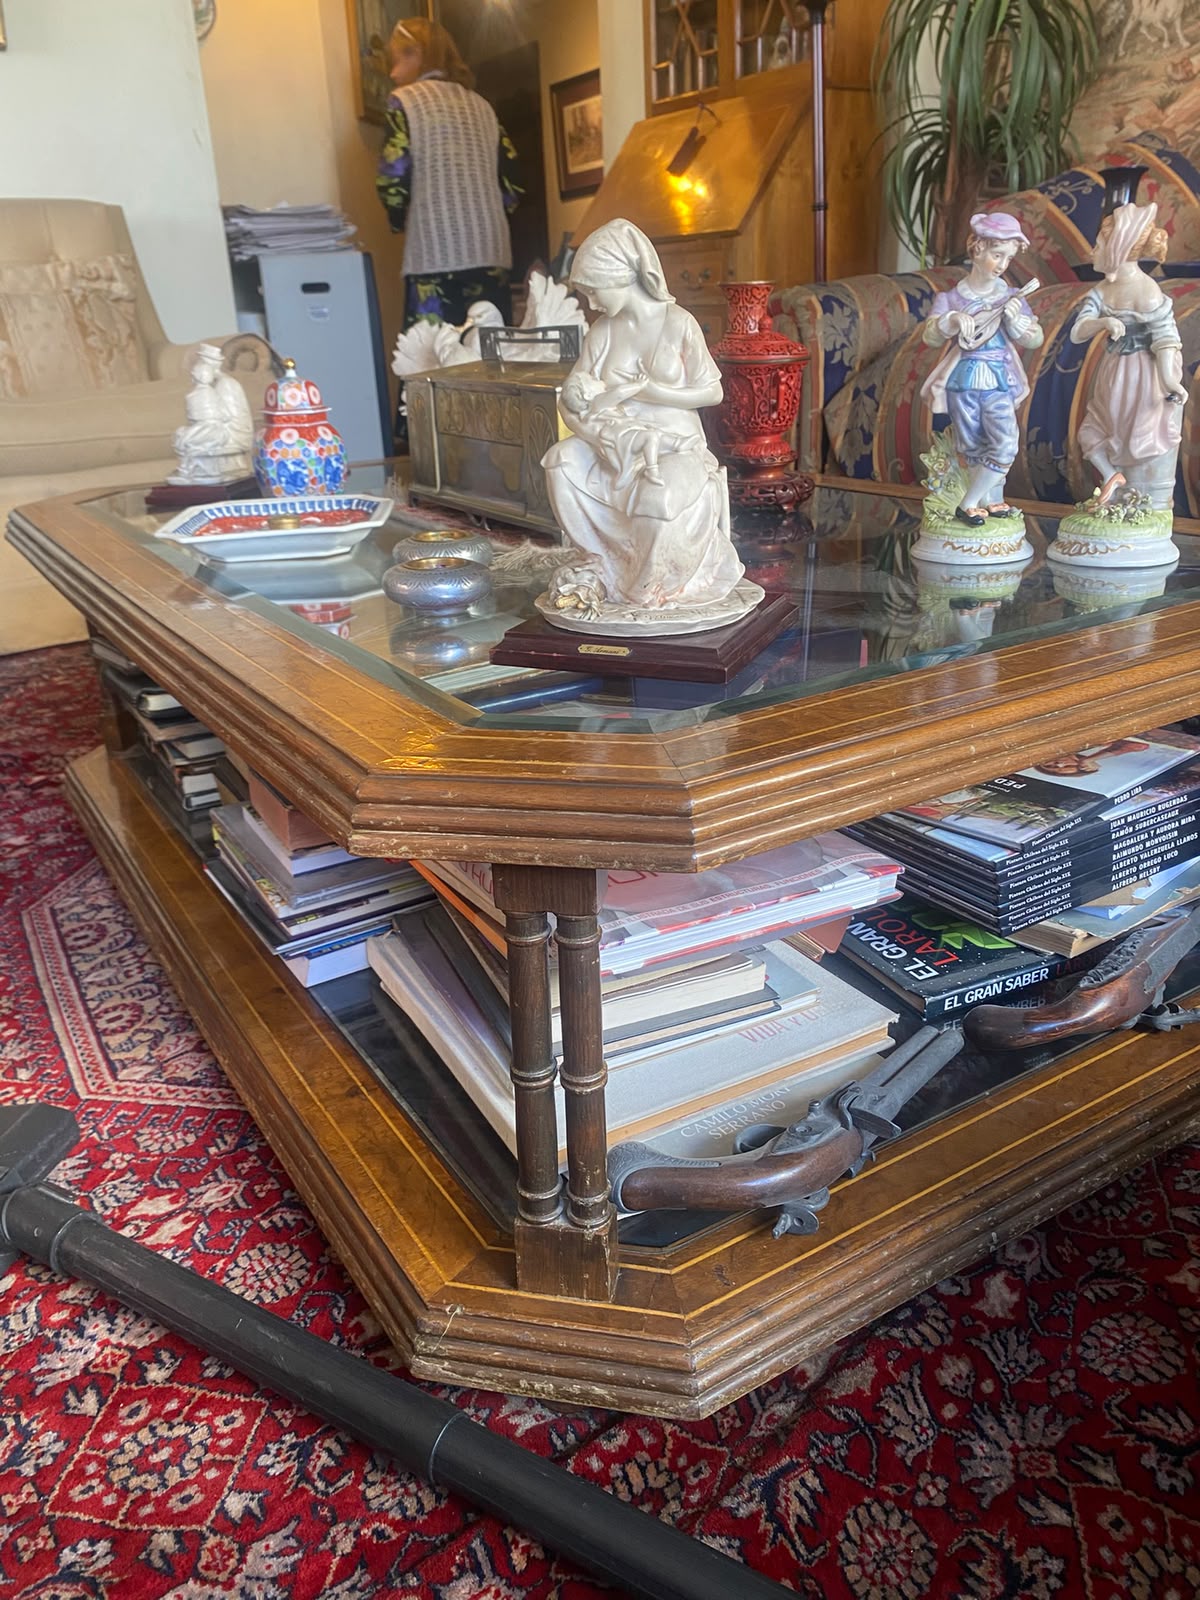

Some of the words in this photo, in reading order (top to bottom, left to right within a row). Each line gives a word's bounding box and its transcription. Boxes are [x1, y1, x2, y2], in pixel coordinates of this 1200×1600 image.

[1111, 818, 1125, 830] JUAN
[1127, 807, 1156, 823] MAURICIO
[1158, 795, 1188, 811] RUGENDAS
[1114, 791, 1130, 805] PEDRO
[1131, 786, 1142, 797] LIRA
[1112, 826, 1133, 840] RAMÓN
[1135, 809, 1179, 831] SUBERCASEAUX
[1114, 831, 1149, 851] MAGDALENA
[1150, 830, 1154, 838] Y
[1156, 821, 1180, 835] AURORA
[1181, 815, 1196, 826] MIRA
[1112, 856, 1138, 871] ALBERTO
[1140, 842, 1175, 860] VALENZUELA
[1177, 833, 1198, 846] LLANOS
[1113, 843, 1144, 861] RAIMUNDO
[1146, 831, 1178, 848] MONVOISIN
[1112, 867, 1137, 881] ALBERTO
[1139, 857, 1162, 870] ORREGO
[1164, 850, 1179, 861] LUCO
[1112, 876, 1137, 891] ALFREDO
[1140, 866, 1161, 880] HELSBY
[846, 922, 907, 959] GRAN
[861, 908, 959, 966] LAROU
[904, 958, 939, 980] EL
[944, 996, 961, 1011] EL
[965, 982, 1003, 1004] GRAN
[1005, 968, 1049, 992] SABER
[681, 1104, 747, 1137] CAMILO
[709, 1100, 786, 1139] SERRANO
